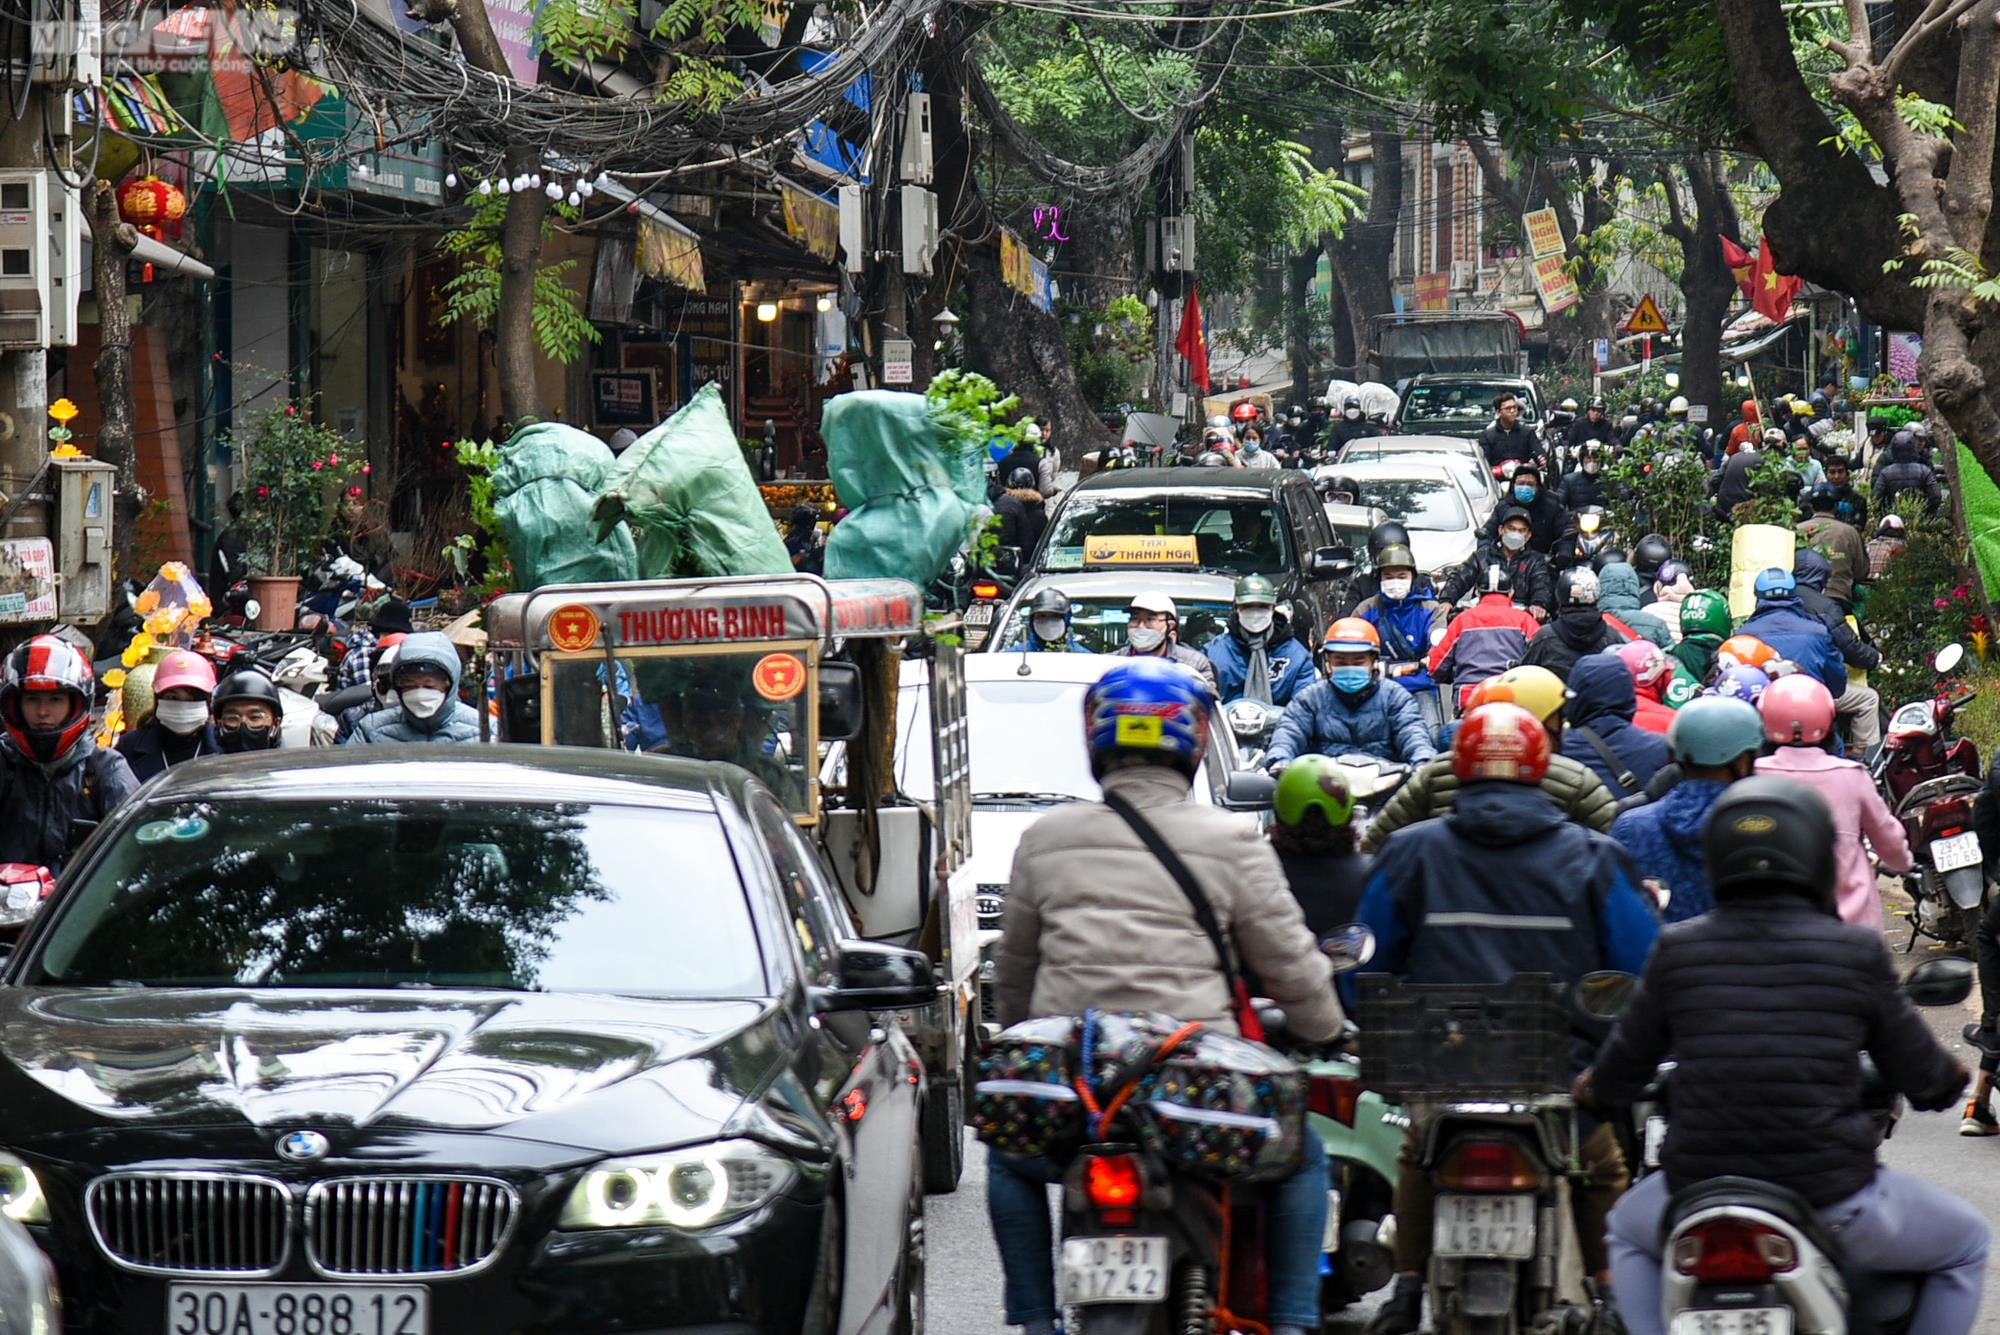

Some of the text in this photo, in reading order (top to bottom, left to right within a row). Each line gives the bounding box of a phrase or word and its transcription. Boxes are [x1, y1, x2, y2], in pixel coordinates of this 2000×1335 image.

[1141, 539, 1167, 547] TAXI
[1120, 550, 1161, 559] THANH
[1166, 550, 1192, 559] NGA
[1681, 607, 1707, 620] Grab
[618, 607, 719, 642] THƯƠNG
[723, 604, 786, 639] BINH
[176, 1291, 418, 1335] 30A-888.12
